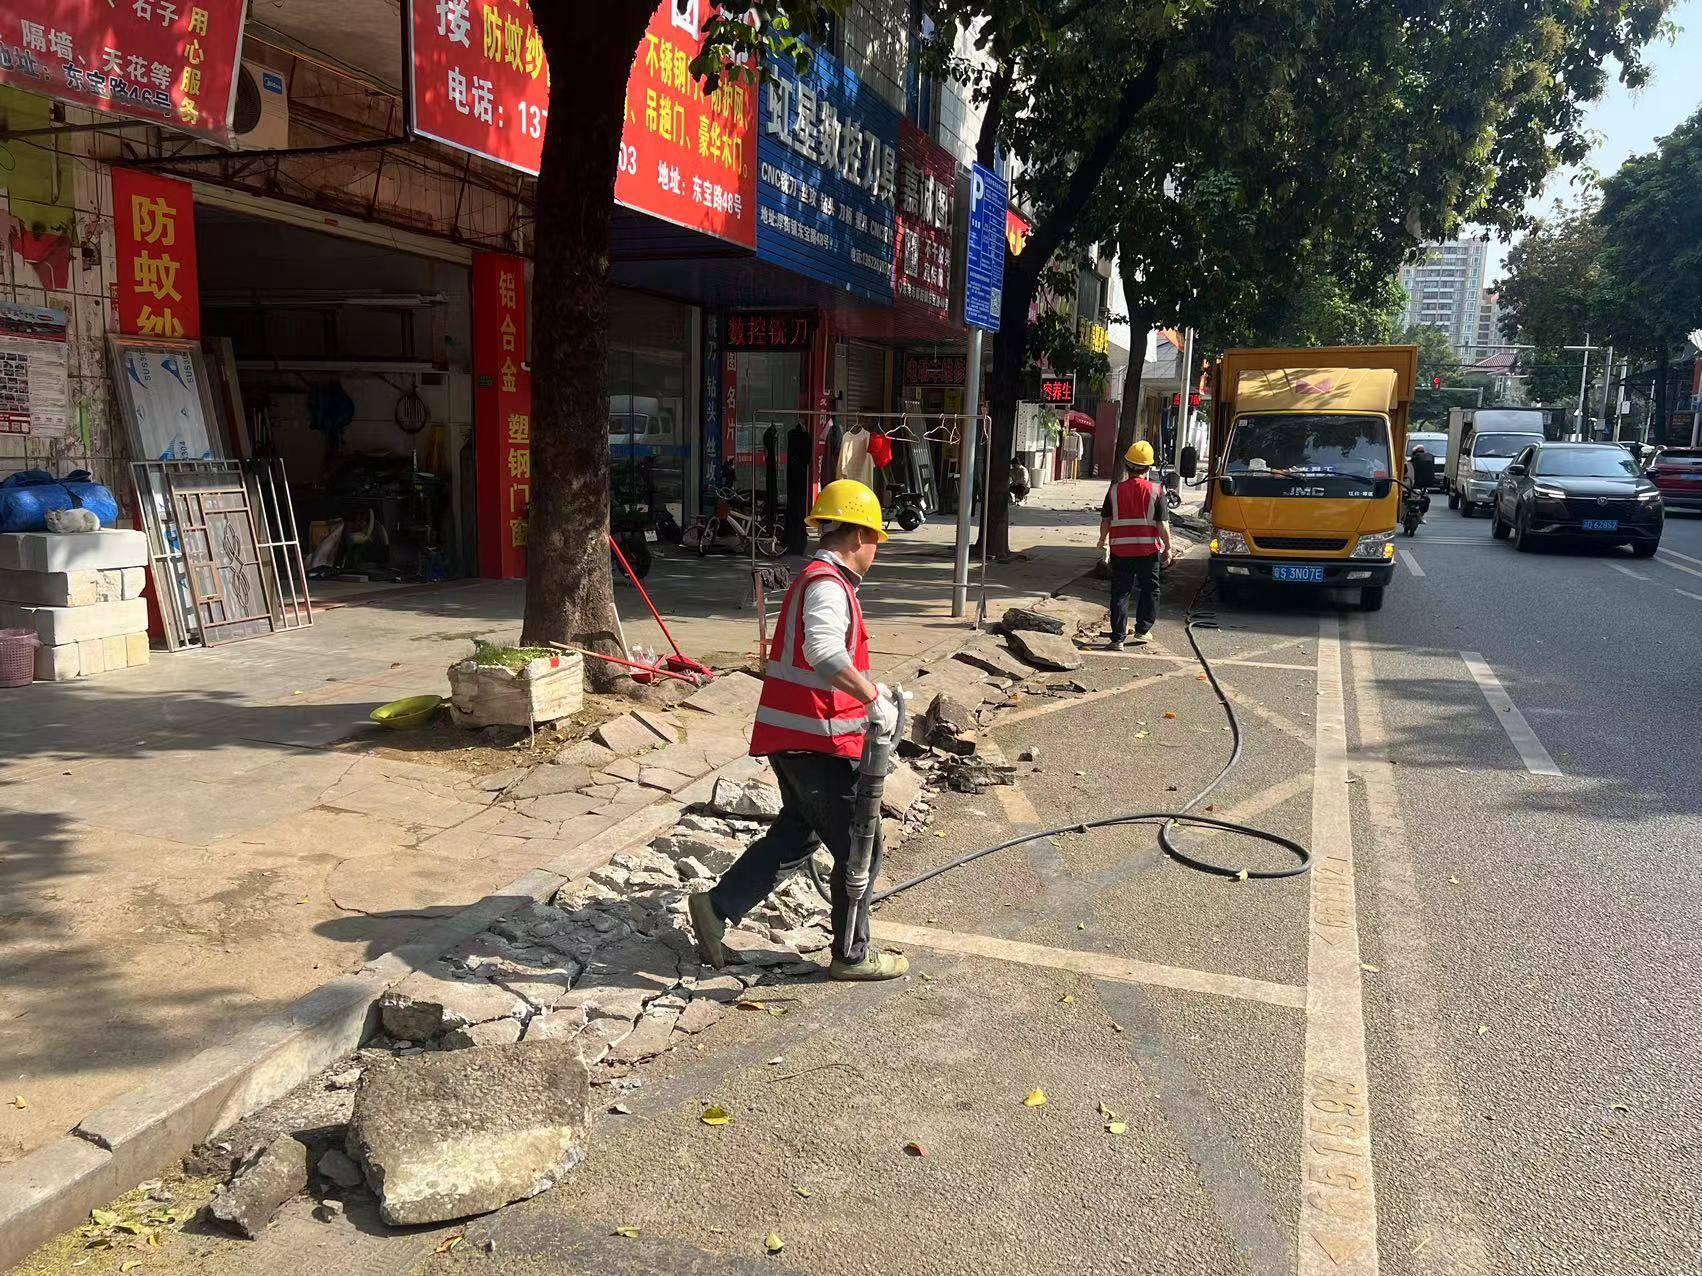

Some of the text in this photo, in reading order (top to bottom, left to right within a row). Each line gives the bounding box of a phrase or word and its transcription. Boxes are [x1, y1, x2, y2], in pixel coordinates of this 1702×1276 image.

[179, 7, 209, 125] 用心服务
[483, 4, 550, 87] 防蚊纱
[624, 88, 748, 178] 、吊趟门、豪华木门。
[657, 160, 742, 219] 地址：东宝路48号
[972, 171, 985, 213] P
[131, 193, 184, 337] 防蚊纱
[499, 270, 517, 393] 铝合金
[728, 316, 807, 346] 数控铣刀
[1288, 486, 1325, 497] JMC
